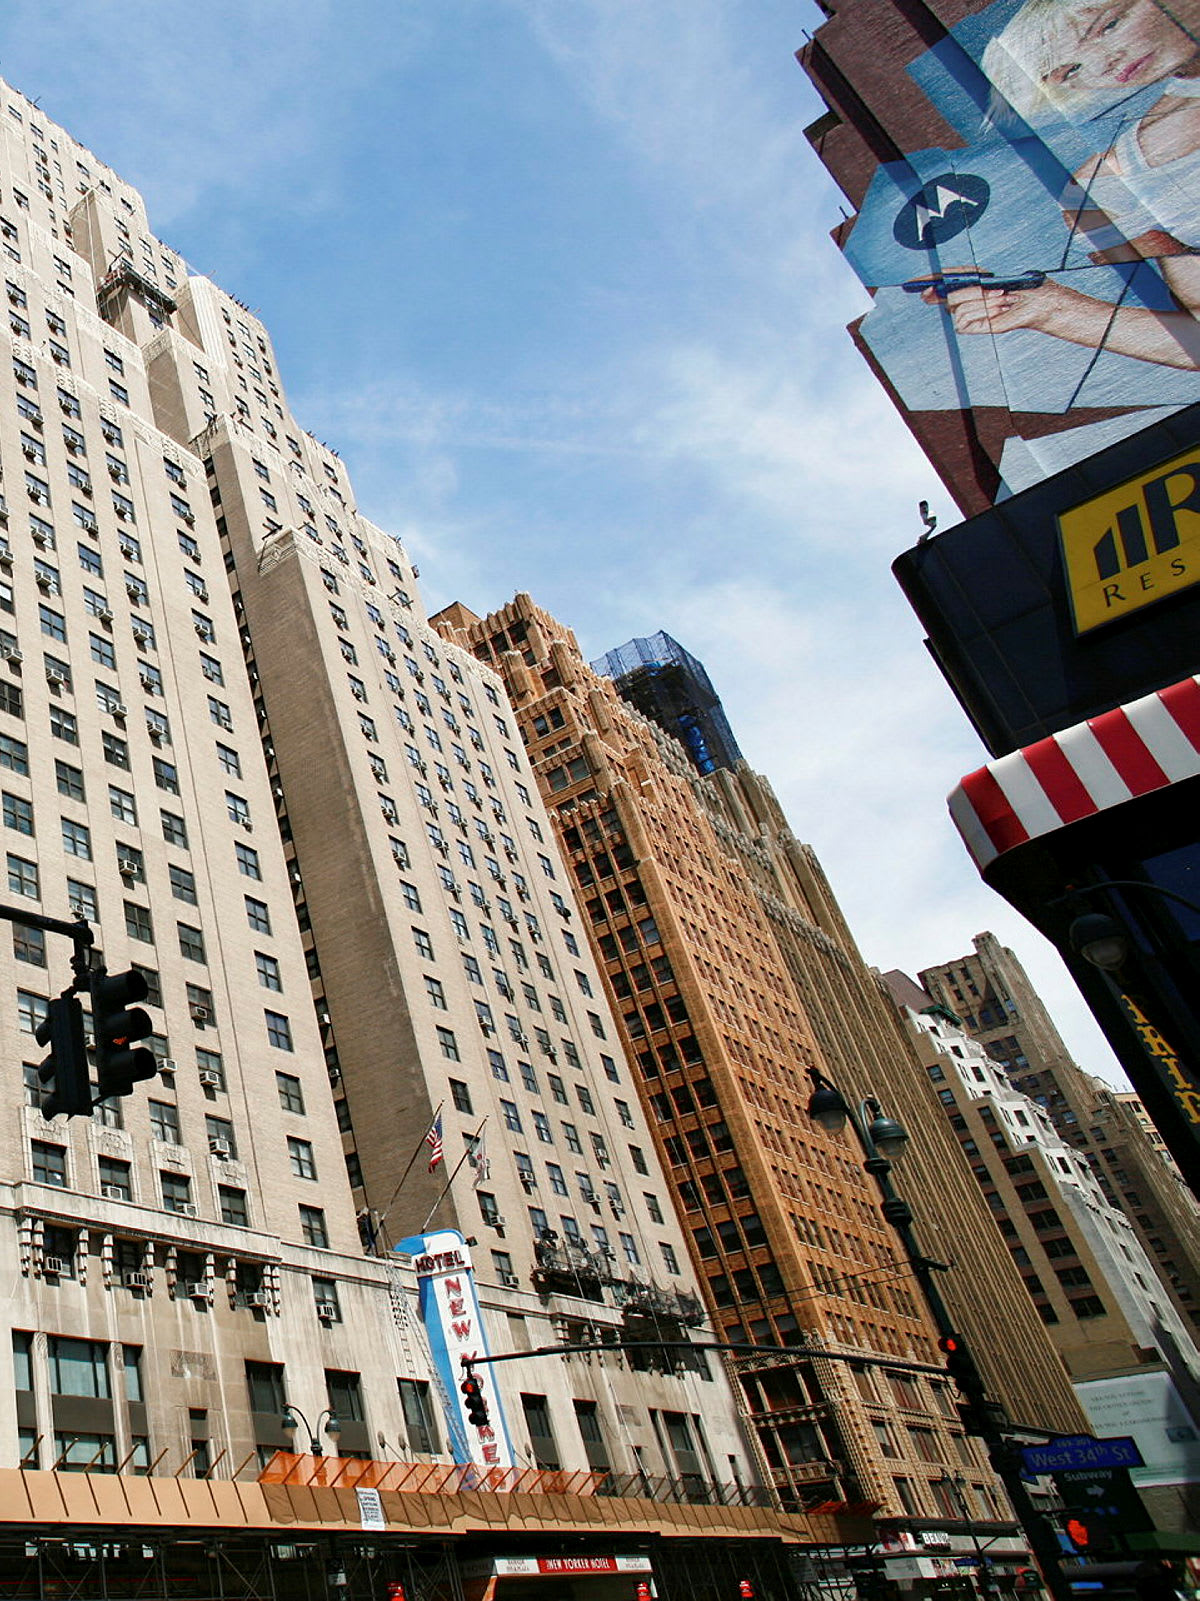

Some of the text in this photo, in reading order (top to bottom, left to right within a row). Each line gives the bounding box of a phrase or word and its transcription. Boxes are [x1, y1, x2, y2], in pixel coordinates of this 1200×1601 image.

[415, 1250, 466, 1275] HOTEL
[444, 1277, 472, 1342] NEW
[1030, 1445, 1132, 1468] West 34th St
[1063, 1469, 1113, 1481] Subway
[563, 1558, 590, 1569] YORKER
